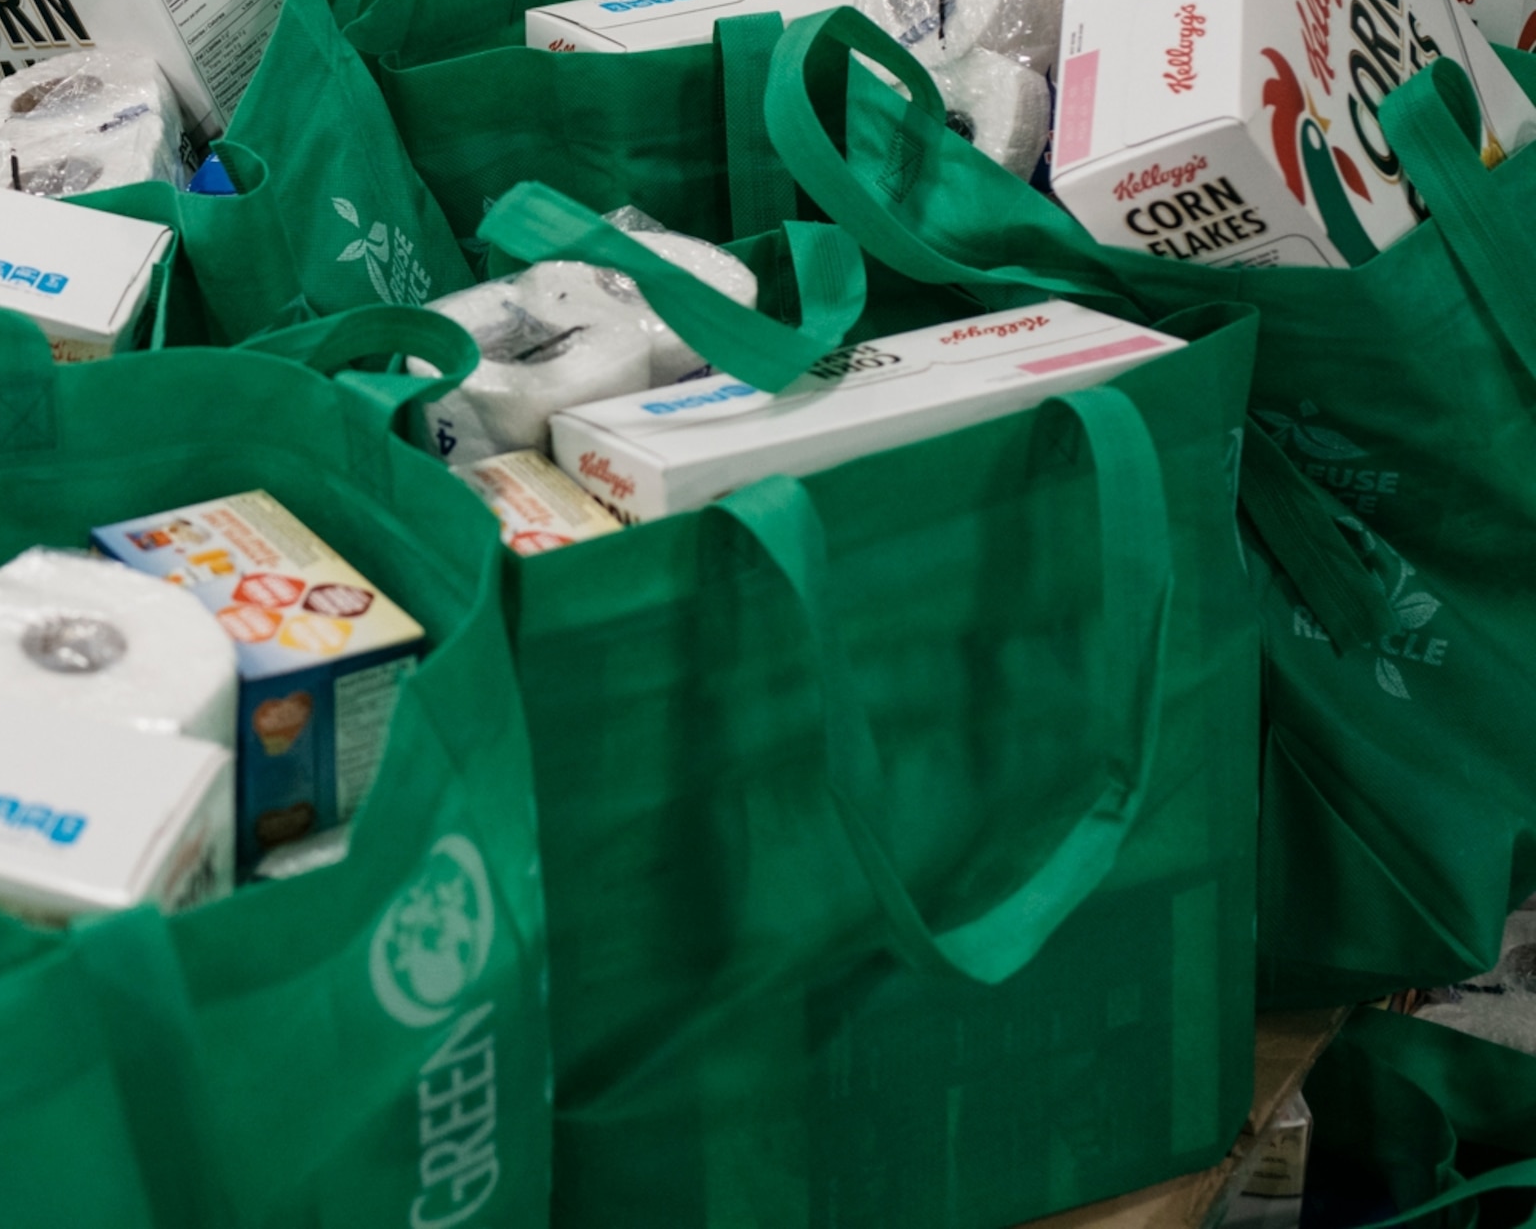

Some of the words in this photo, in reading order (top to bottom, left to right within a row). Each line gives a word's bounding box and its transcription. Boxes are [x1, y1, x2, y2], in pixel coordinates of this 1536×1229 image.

[1164, 2, 1208, 94] Kellogg's
[1113, 153, 1209, 201] Kellogg's
[1126, 176, 1246, 238] CORN
[1149, 208, 1267, 262] FLAKES
[939, 314, 1051, 348] Kellogg's
[578, 450, 637, 500] Kellogg's
[410, 1001, 500, 1229] GREEN
